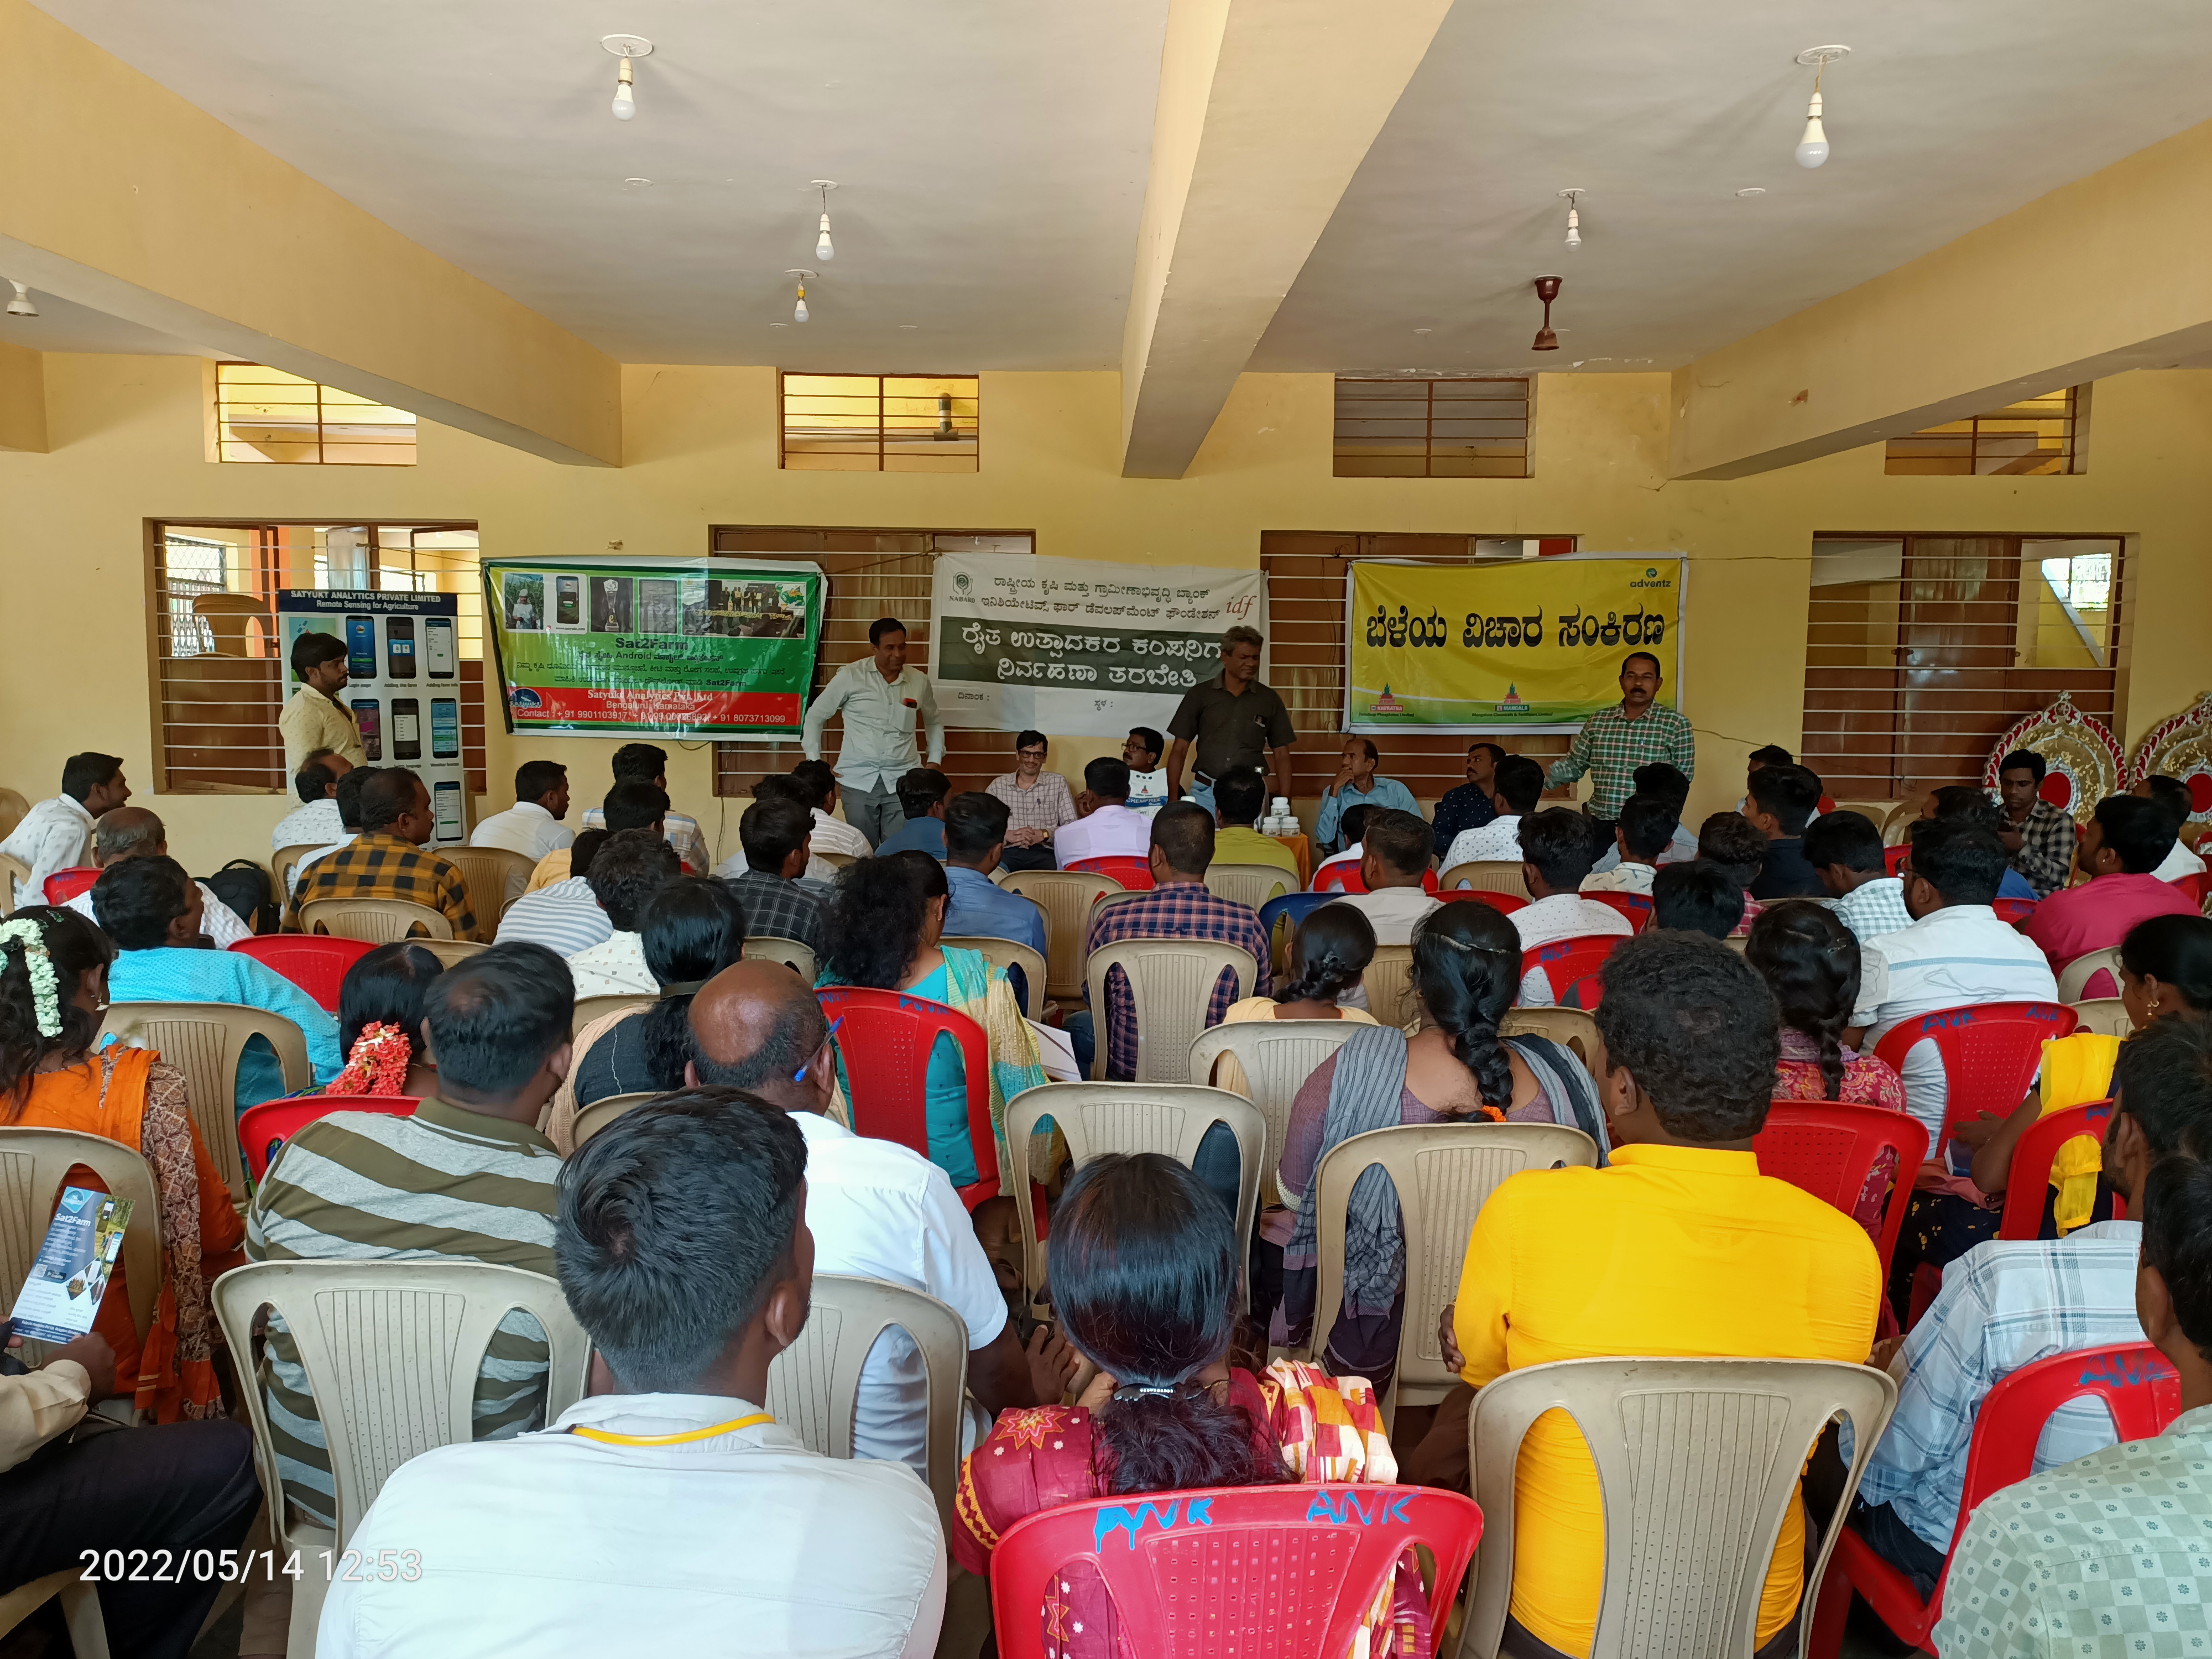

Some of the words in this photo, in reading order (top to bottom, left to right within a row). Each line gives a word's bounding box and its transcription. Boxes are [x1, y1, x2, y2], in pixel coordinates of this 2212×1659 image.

[1630, 579, 1671, 587] adventz
[291, 590, 329, 598] SATYUKT
[331, 591, 375, 600] ANALYTICS
[377, 593, 409, 601] PRIVATE
[410, 594, 441, 602] LIMITED
[994, 577, 1035, 594] ರಾಷ್ಟ್ರೀಯ
[1041, 579, 1058, 595] ಕೃಷಿ
[1064, 581, 1089, 597] ಮತ್ತು
[1177, 588, 1210, 604] ಬ್ಯಾಂಕ್
[317, 600, 342, 608] Remote
[344, 601, 371, 610] Sensing
[383, 602, 419, 611] Agriculture
[1226, 596, 1257, 620] idf
[1366, 605, 1447, 648] ಬೆಳೆಯ
[1462, 605, 1543, 648] ವಿಚಾರ
[1558, 603, 1665, 647] ಸಂಕಿರಣ
[615, 638, 688, 650] Sat2Farm
[962, 622, 1001, 654] ರೈತ
[1010, 630, 1120, 659] ಉತ್ಪಾದಕರ
[1131, 639, 1222, 662] ಕಂಪನಿಗ
[615, 651, 652, 660] Android
[997, 658, 1098, 682] ನಿರ್ವಹಣಾ
[1109, 664, 1197, 687] ತರಬೇತಿ
[957, 691, 984, 701] ದಿನಾಂಕ
[654, 701, 695, 710] Karnataka
[517, 709, 550, 717] Contact
[55, 1213, 91, 1227] Sat2Farm
[1306, 1491, 1420, 1525] ANK
